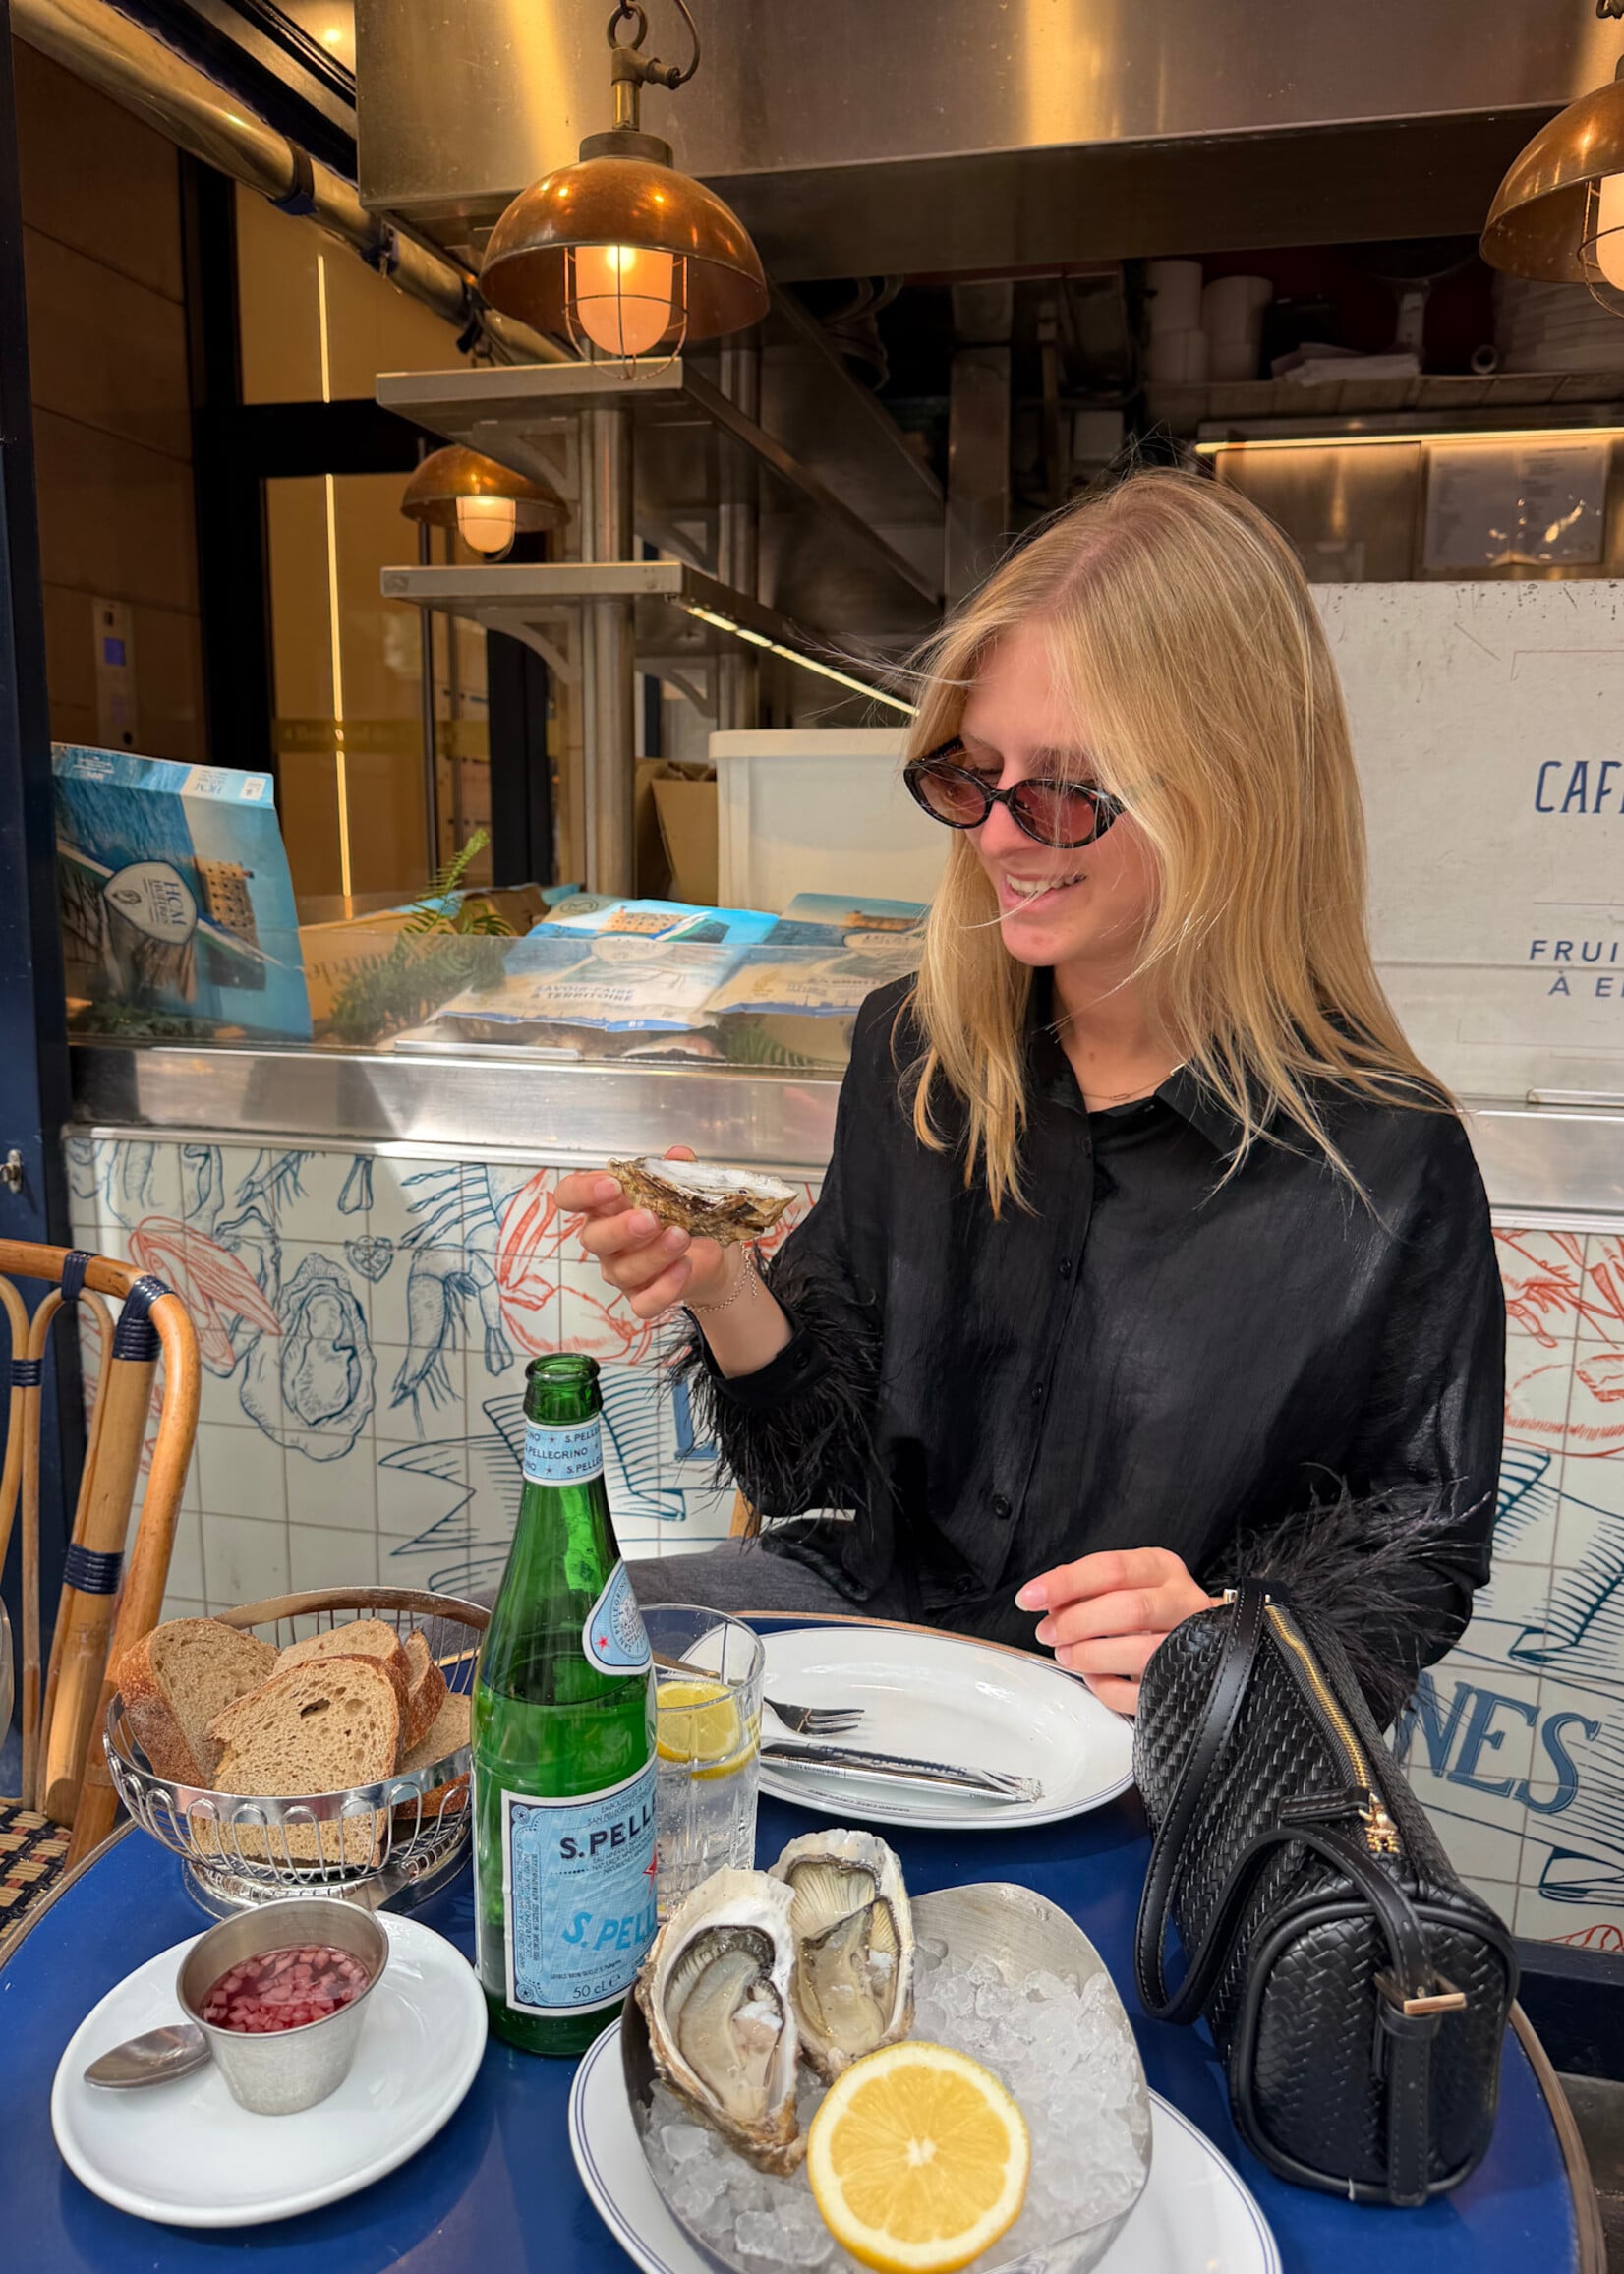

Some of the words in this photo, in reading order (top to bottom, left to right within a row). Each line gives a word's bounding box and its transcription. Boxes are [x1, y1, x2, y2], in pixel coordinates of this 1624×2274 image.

[1535, 760, 1624, 814] CAF
[164, 881, 188, 925] HCM
[1530, 940, 1618, 962] FRUI
[547, 990, 633, 1001] TERRITOIRE
[1548, 969, 1571, 997] À
[1595, 977, 1624, 998] E
[573, 1984, 591, 1999] 50
